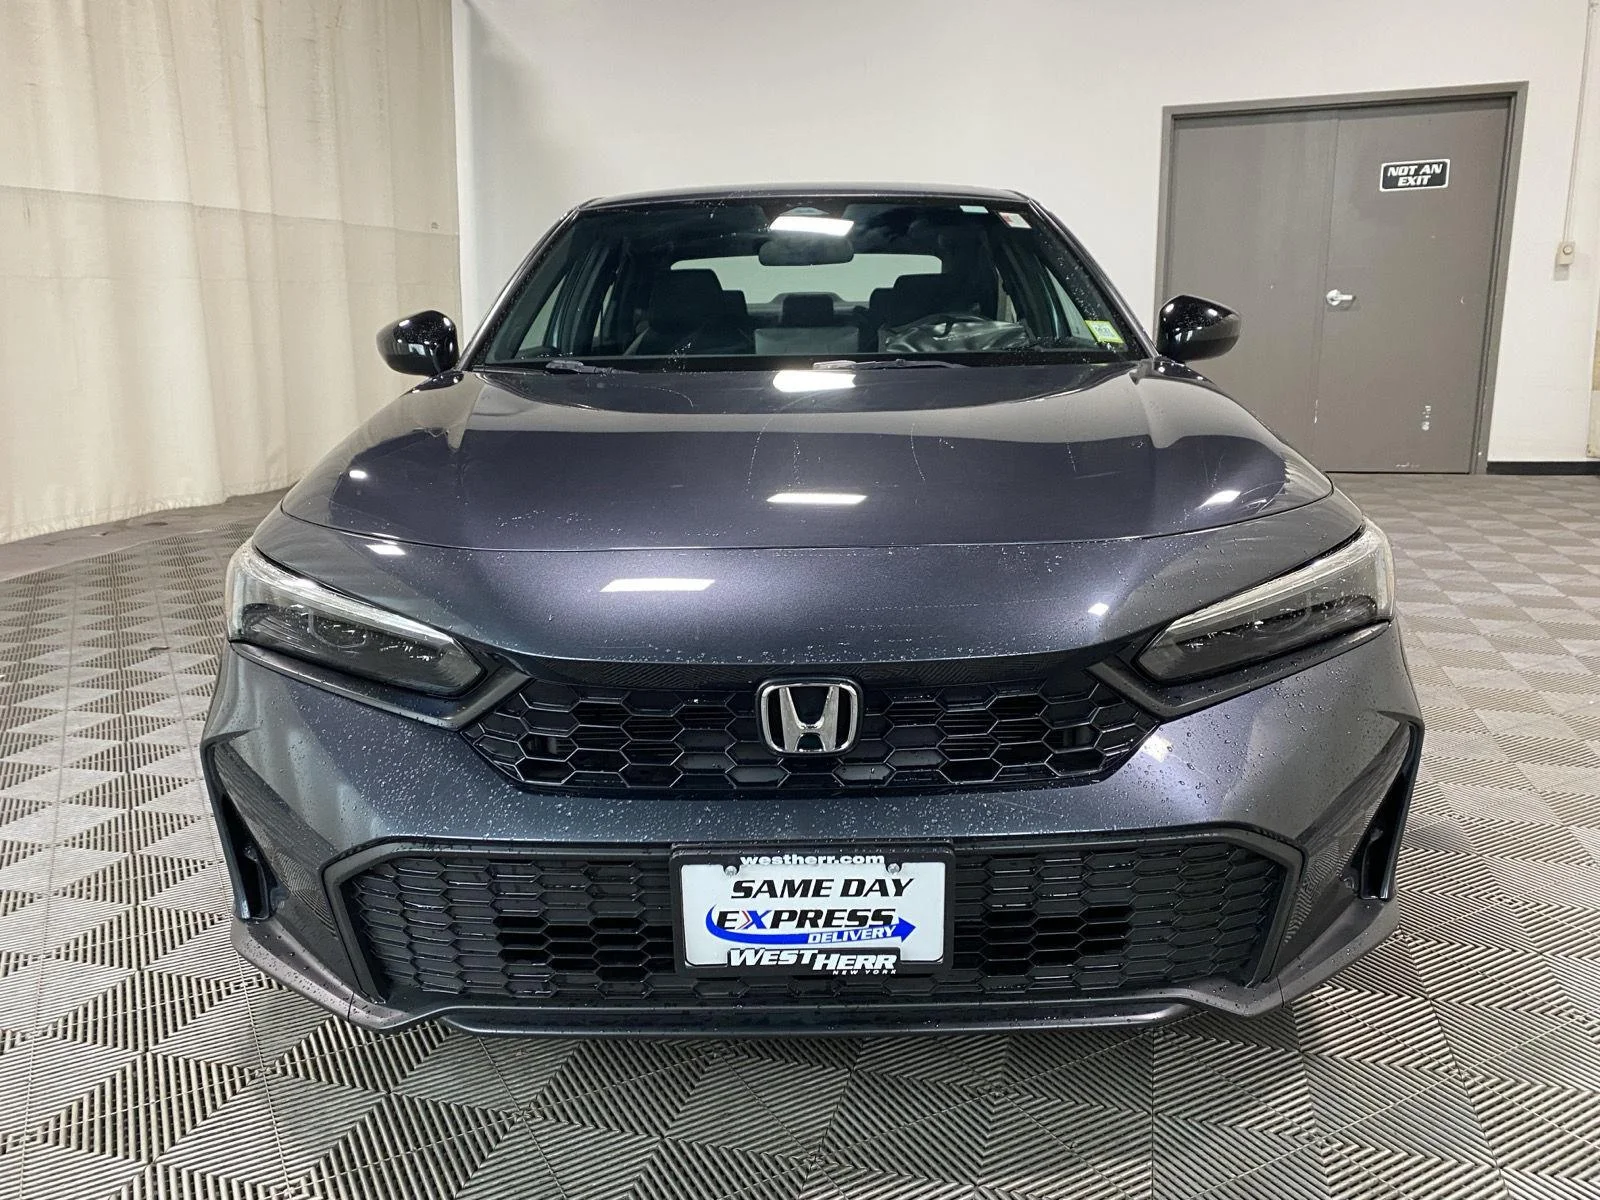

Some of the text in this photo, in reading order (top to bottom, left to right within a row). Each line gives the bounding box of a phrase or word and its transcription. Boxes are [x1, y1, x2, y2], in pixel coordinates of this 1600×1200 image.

[1387, 163, 1443, 177] NOT AN
[1398, 175, 1431, 187] EXIT
[740, 854, 885, 866] westherr.com
[731, 878, 915, 899] SAME DAY
[716, 908, 896, 930] EXPRESS
[807, 925, 897, 945] DELIVERY
